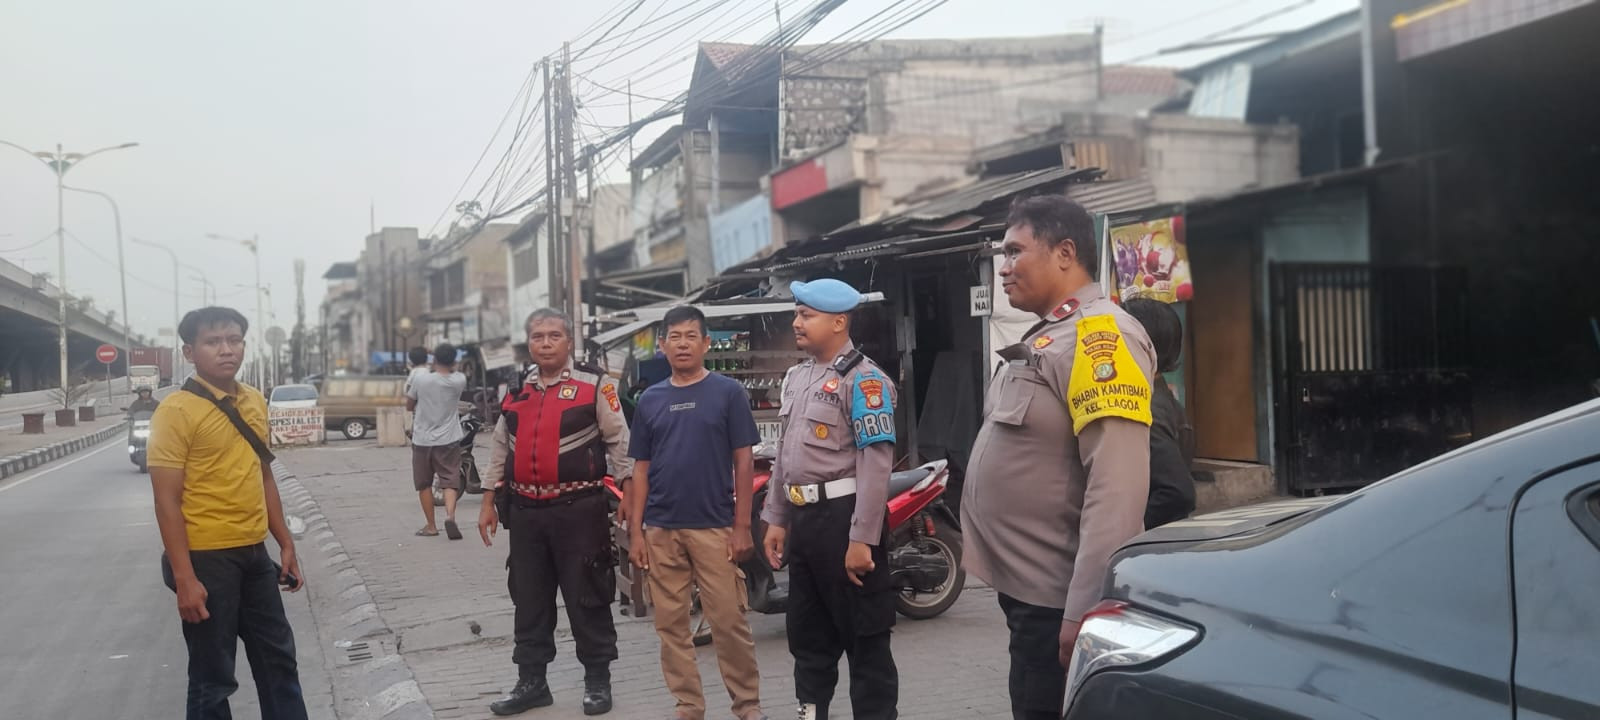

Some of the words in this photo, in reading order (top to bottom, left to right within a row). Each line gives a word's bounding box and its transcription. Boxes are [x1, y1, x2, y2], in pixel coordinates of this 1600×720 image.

[1072, 387, 1099, 409] BHABIN
[1101, 384, 1148, 400] KAMTIBMAS
[1107, 399, 1140, 411] LAGOA
[854, 412, 895, 443] PRO
